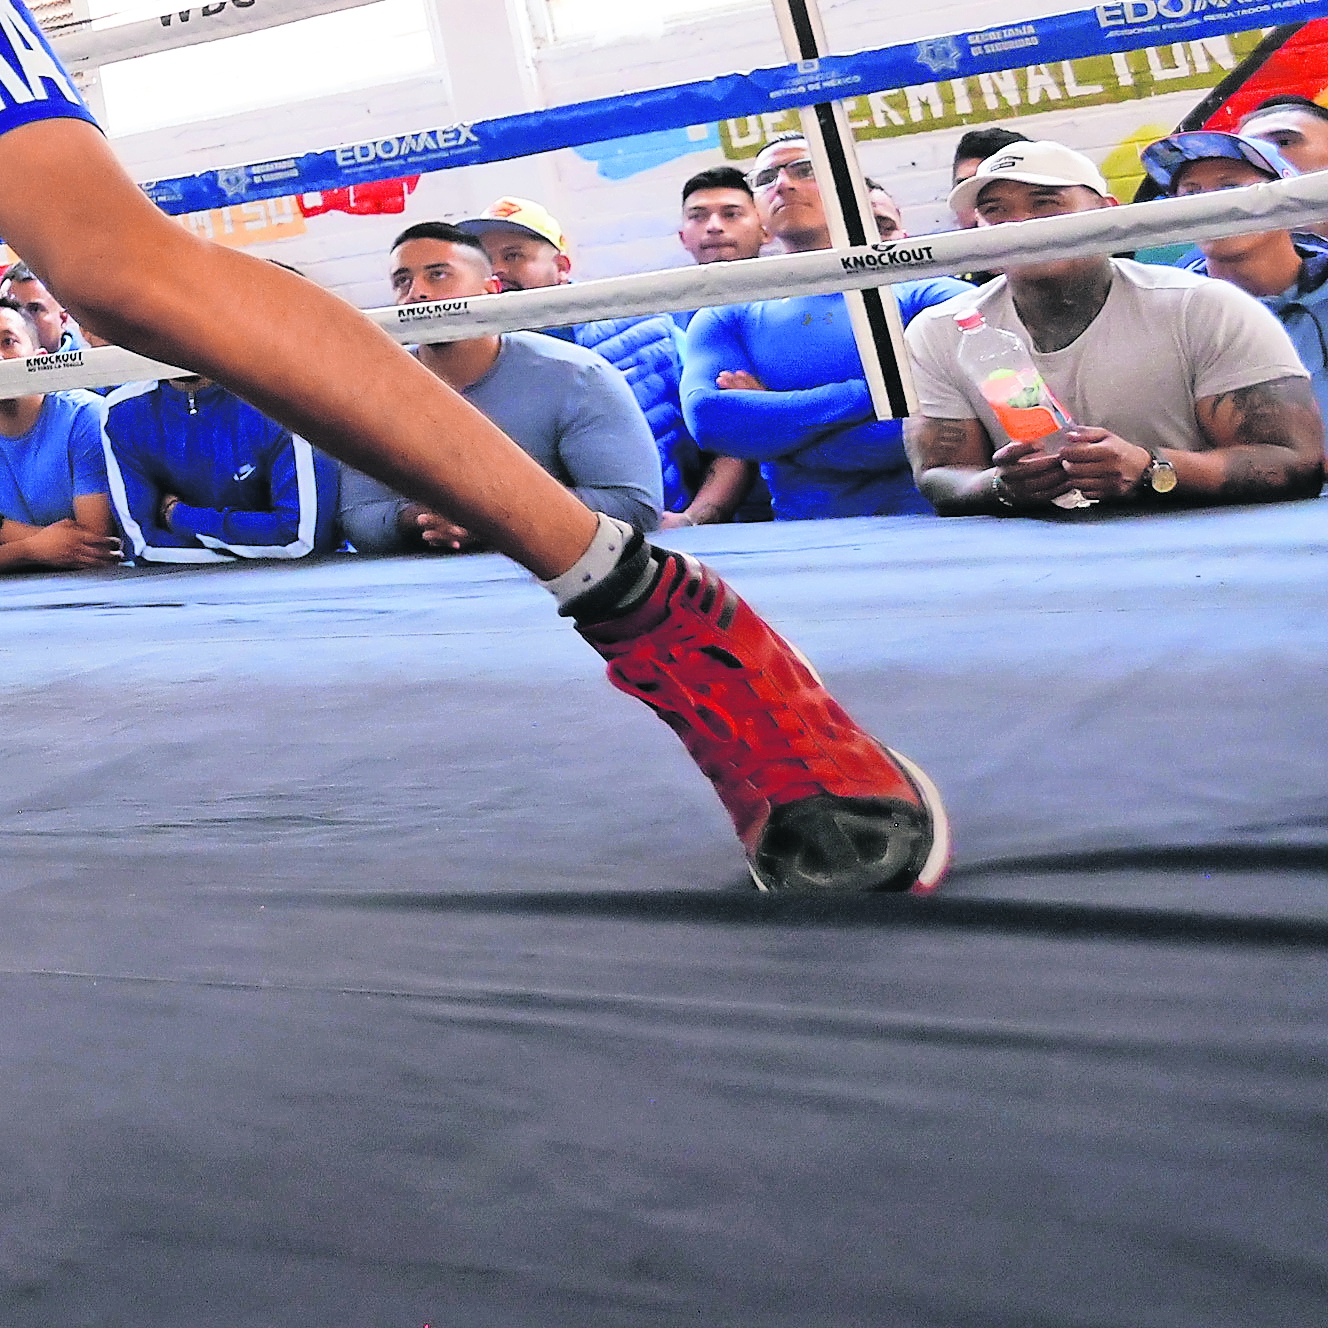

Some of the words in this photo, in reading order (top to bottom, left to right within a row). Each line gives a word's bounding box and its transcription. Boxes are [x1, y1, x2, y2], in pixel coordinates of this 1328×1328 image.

[335, 124, 479, 167] EDOMEX
[840, 246, 933, 270] KNOCKOUT
[26, 352, 83, 367] KNOCKOUT
